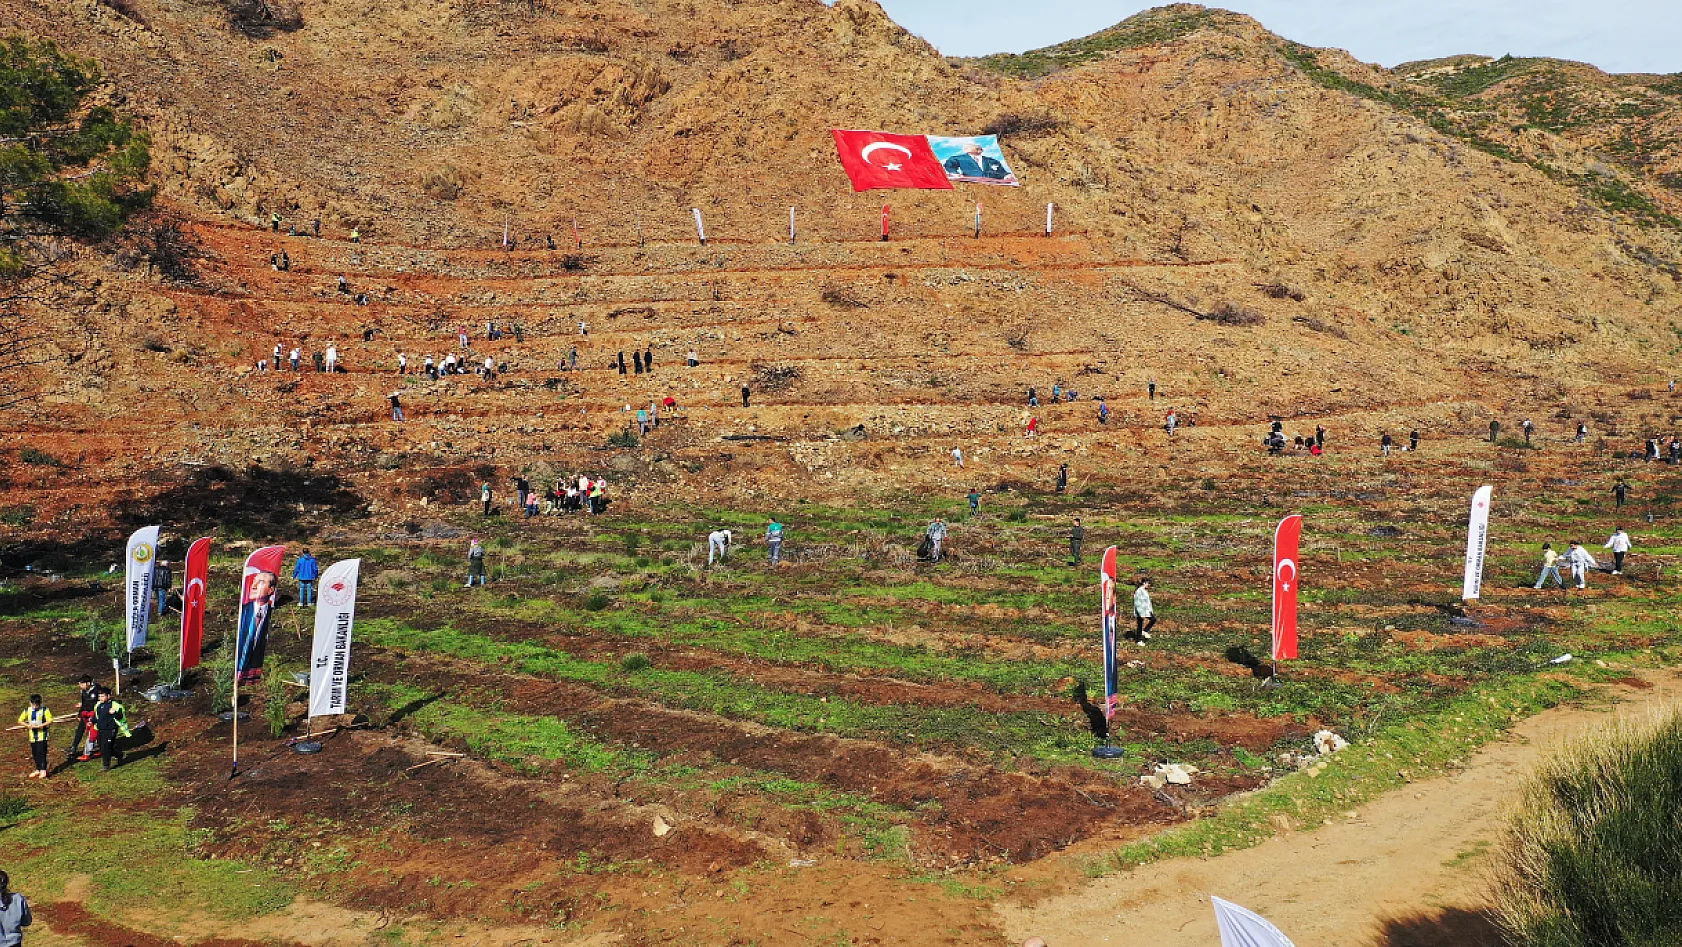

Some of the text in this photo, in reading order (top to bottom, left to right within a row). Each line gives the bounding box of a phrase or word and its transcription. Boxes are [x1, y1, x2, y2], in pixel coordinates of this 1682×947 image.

[316, 655, 328, 669] T.C.
[330, 612, 350, 709] TARIM VE ORMAN BAKANLIĞI
